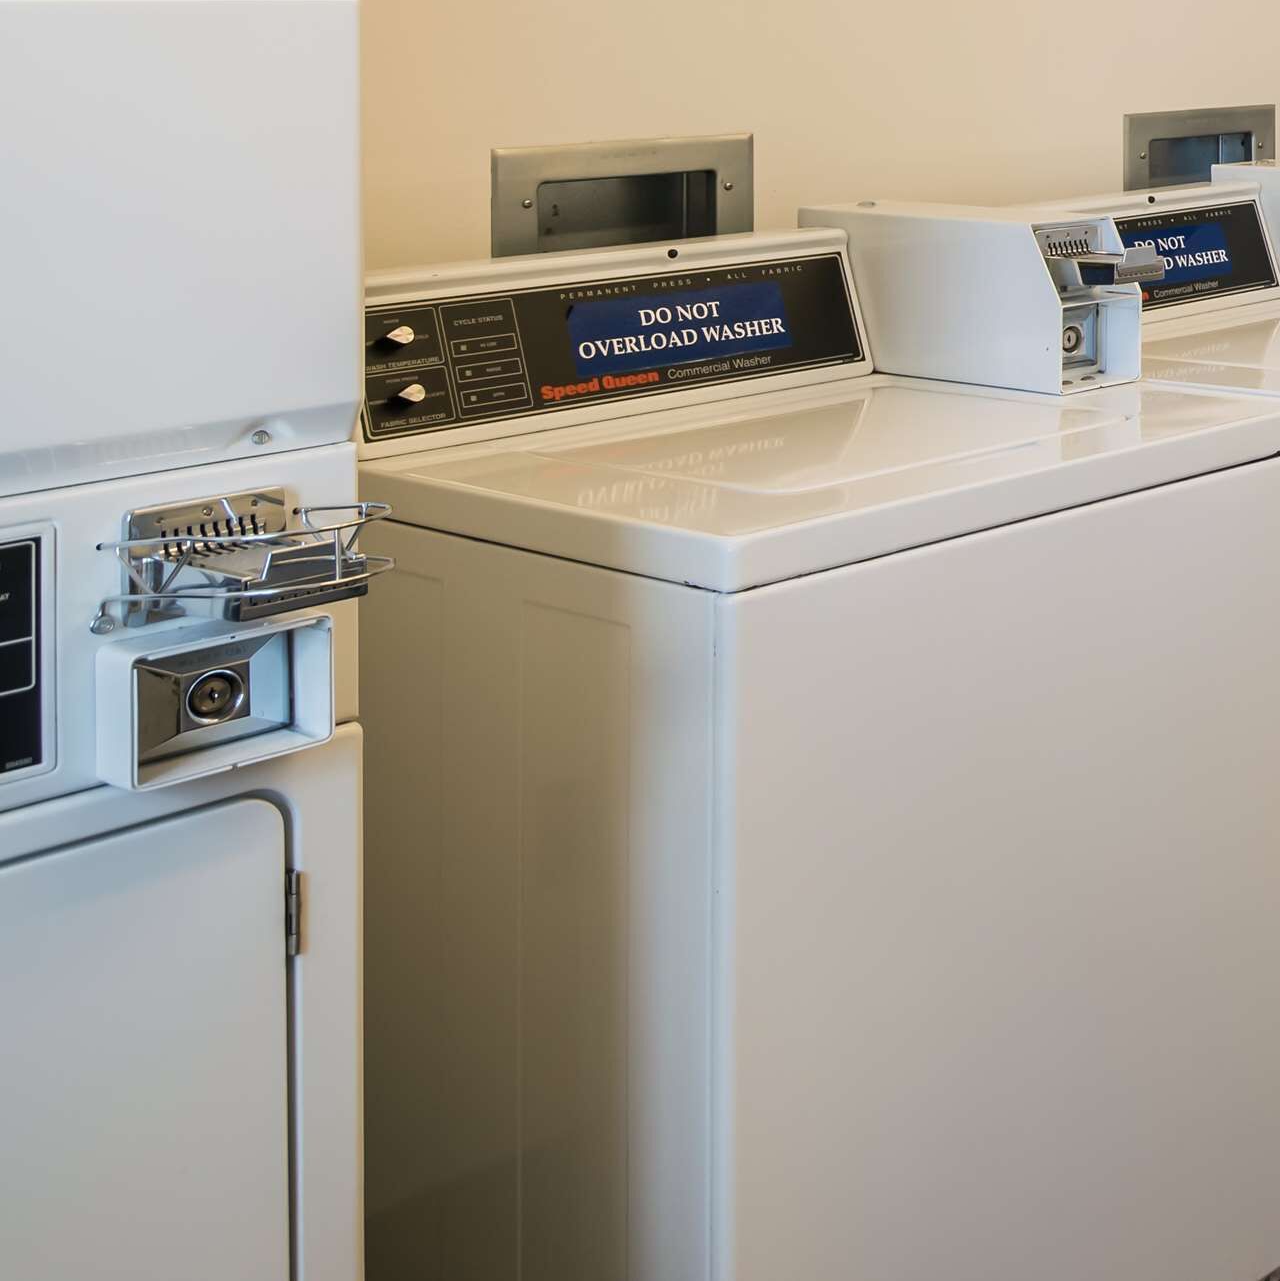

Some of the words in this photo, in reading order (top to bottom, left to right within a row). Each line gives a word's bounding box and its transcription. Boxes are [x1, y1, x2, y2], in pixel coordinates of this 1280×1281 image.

[1157, 235, 1186, 252] NOT
[1173, 249, 1229, 269] WASHER
[560, 284, 637, 300] PERMANENT
[652, 278, 692, 289] PRESS
[727, 271, 748, 280] ALL
[761, 265, 803, 276] FABRIC
[1153, 284, 1193, 299] Commercial
[1194, 280, 1219, 292] Washer
[638, 306, 672, 326] DO
[675, 301, 720, 322] NOT
[578, 328, 698, 359] OVERLOAD
[701, 316, 786, 343] WASHER
[540, 375, 600, 401] Speed
[602, 370, 660, 390] Queen
[667, 361, 731, 380] Commercial
[732, 354, 773, 369] Washer
